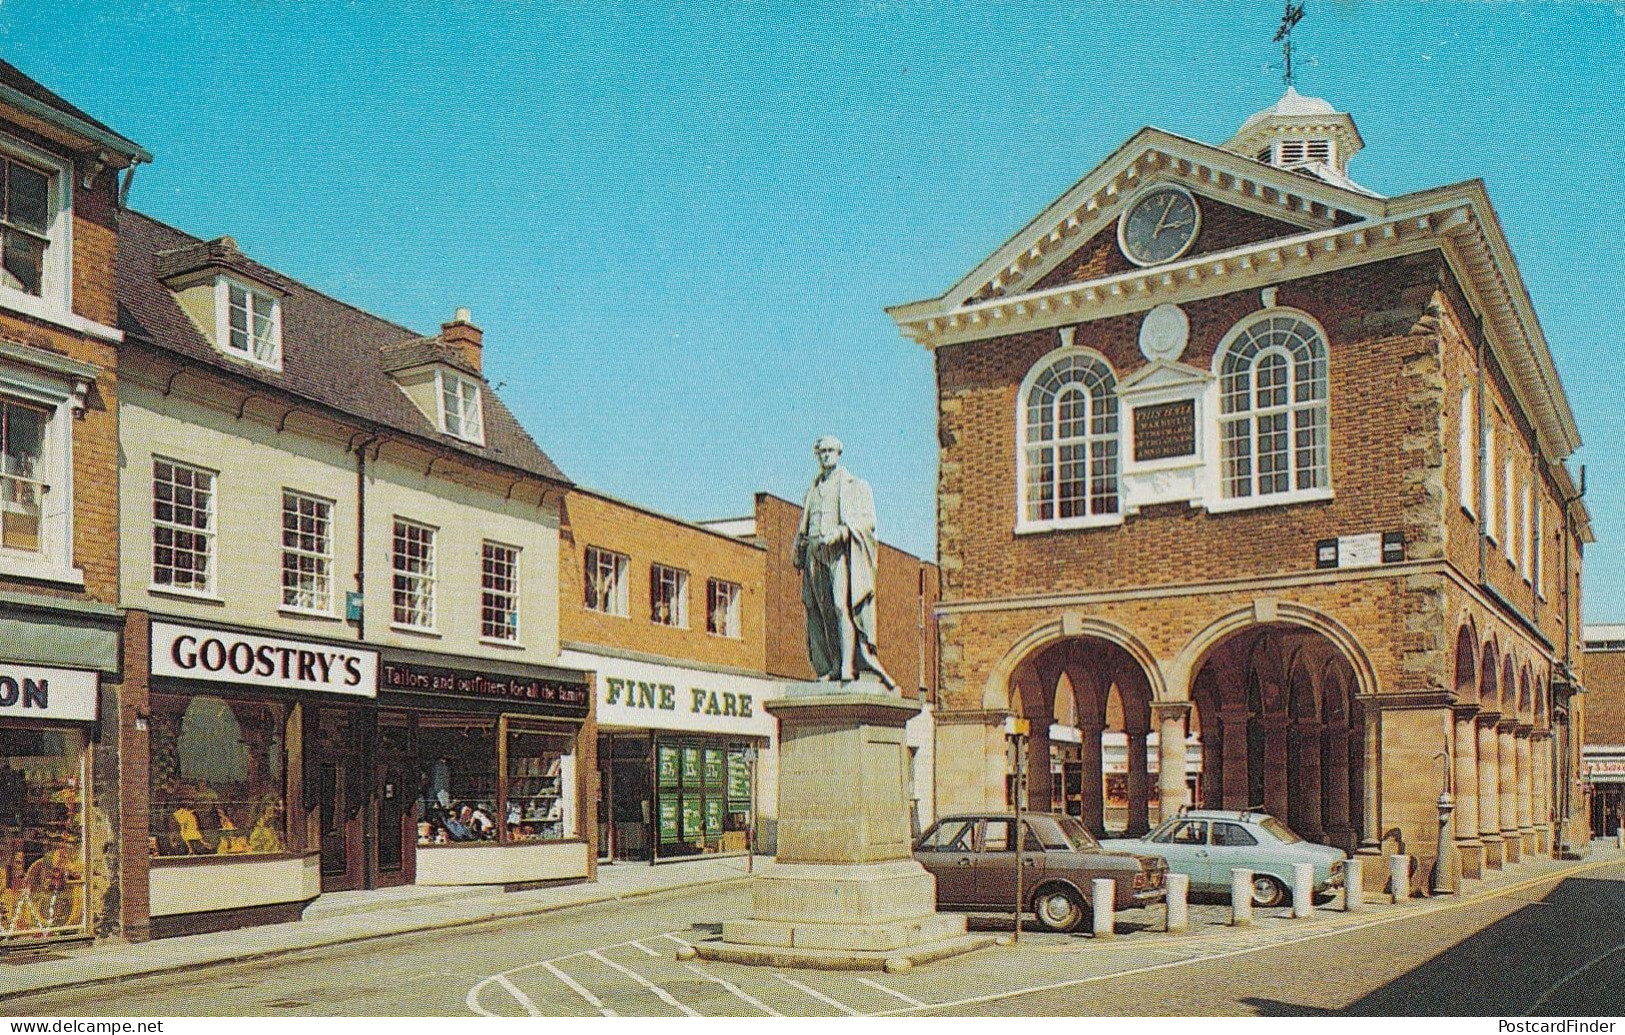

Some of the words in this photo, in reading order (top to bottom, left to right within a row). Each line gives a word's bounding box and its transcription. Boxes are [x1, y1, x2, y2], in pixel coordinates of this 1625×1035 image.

[171, 635, 361, 686] GOOSTRY'S
[385, 666, 430, 688] Tailors
[433, 673, 455, 690] and
[510, 680, 525, 696] for
[526, 682, 539, 697] all
[541, 684, 555, 699] the
[559, 684, 586, 705] family
[606, 676, 676, 711] FINE
[690, 687, 753, 718] FARE
